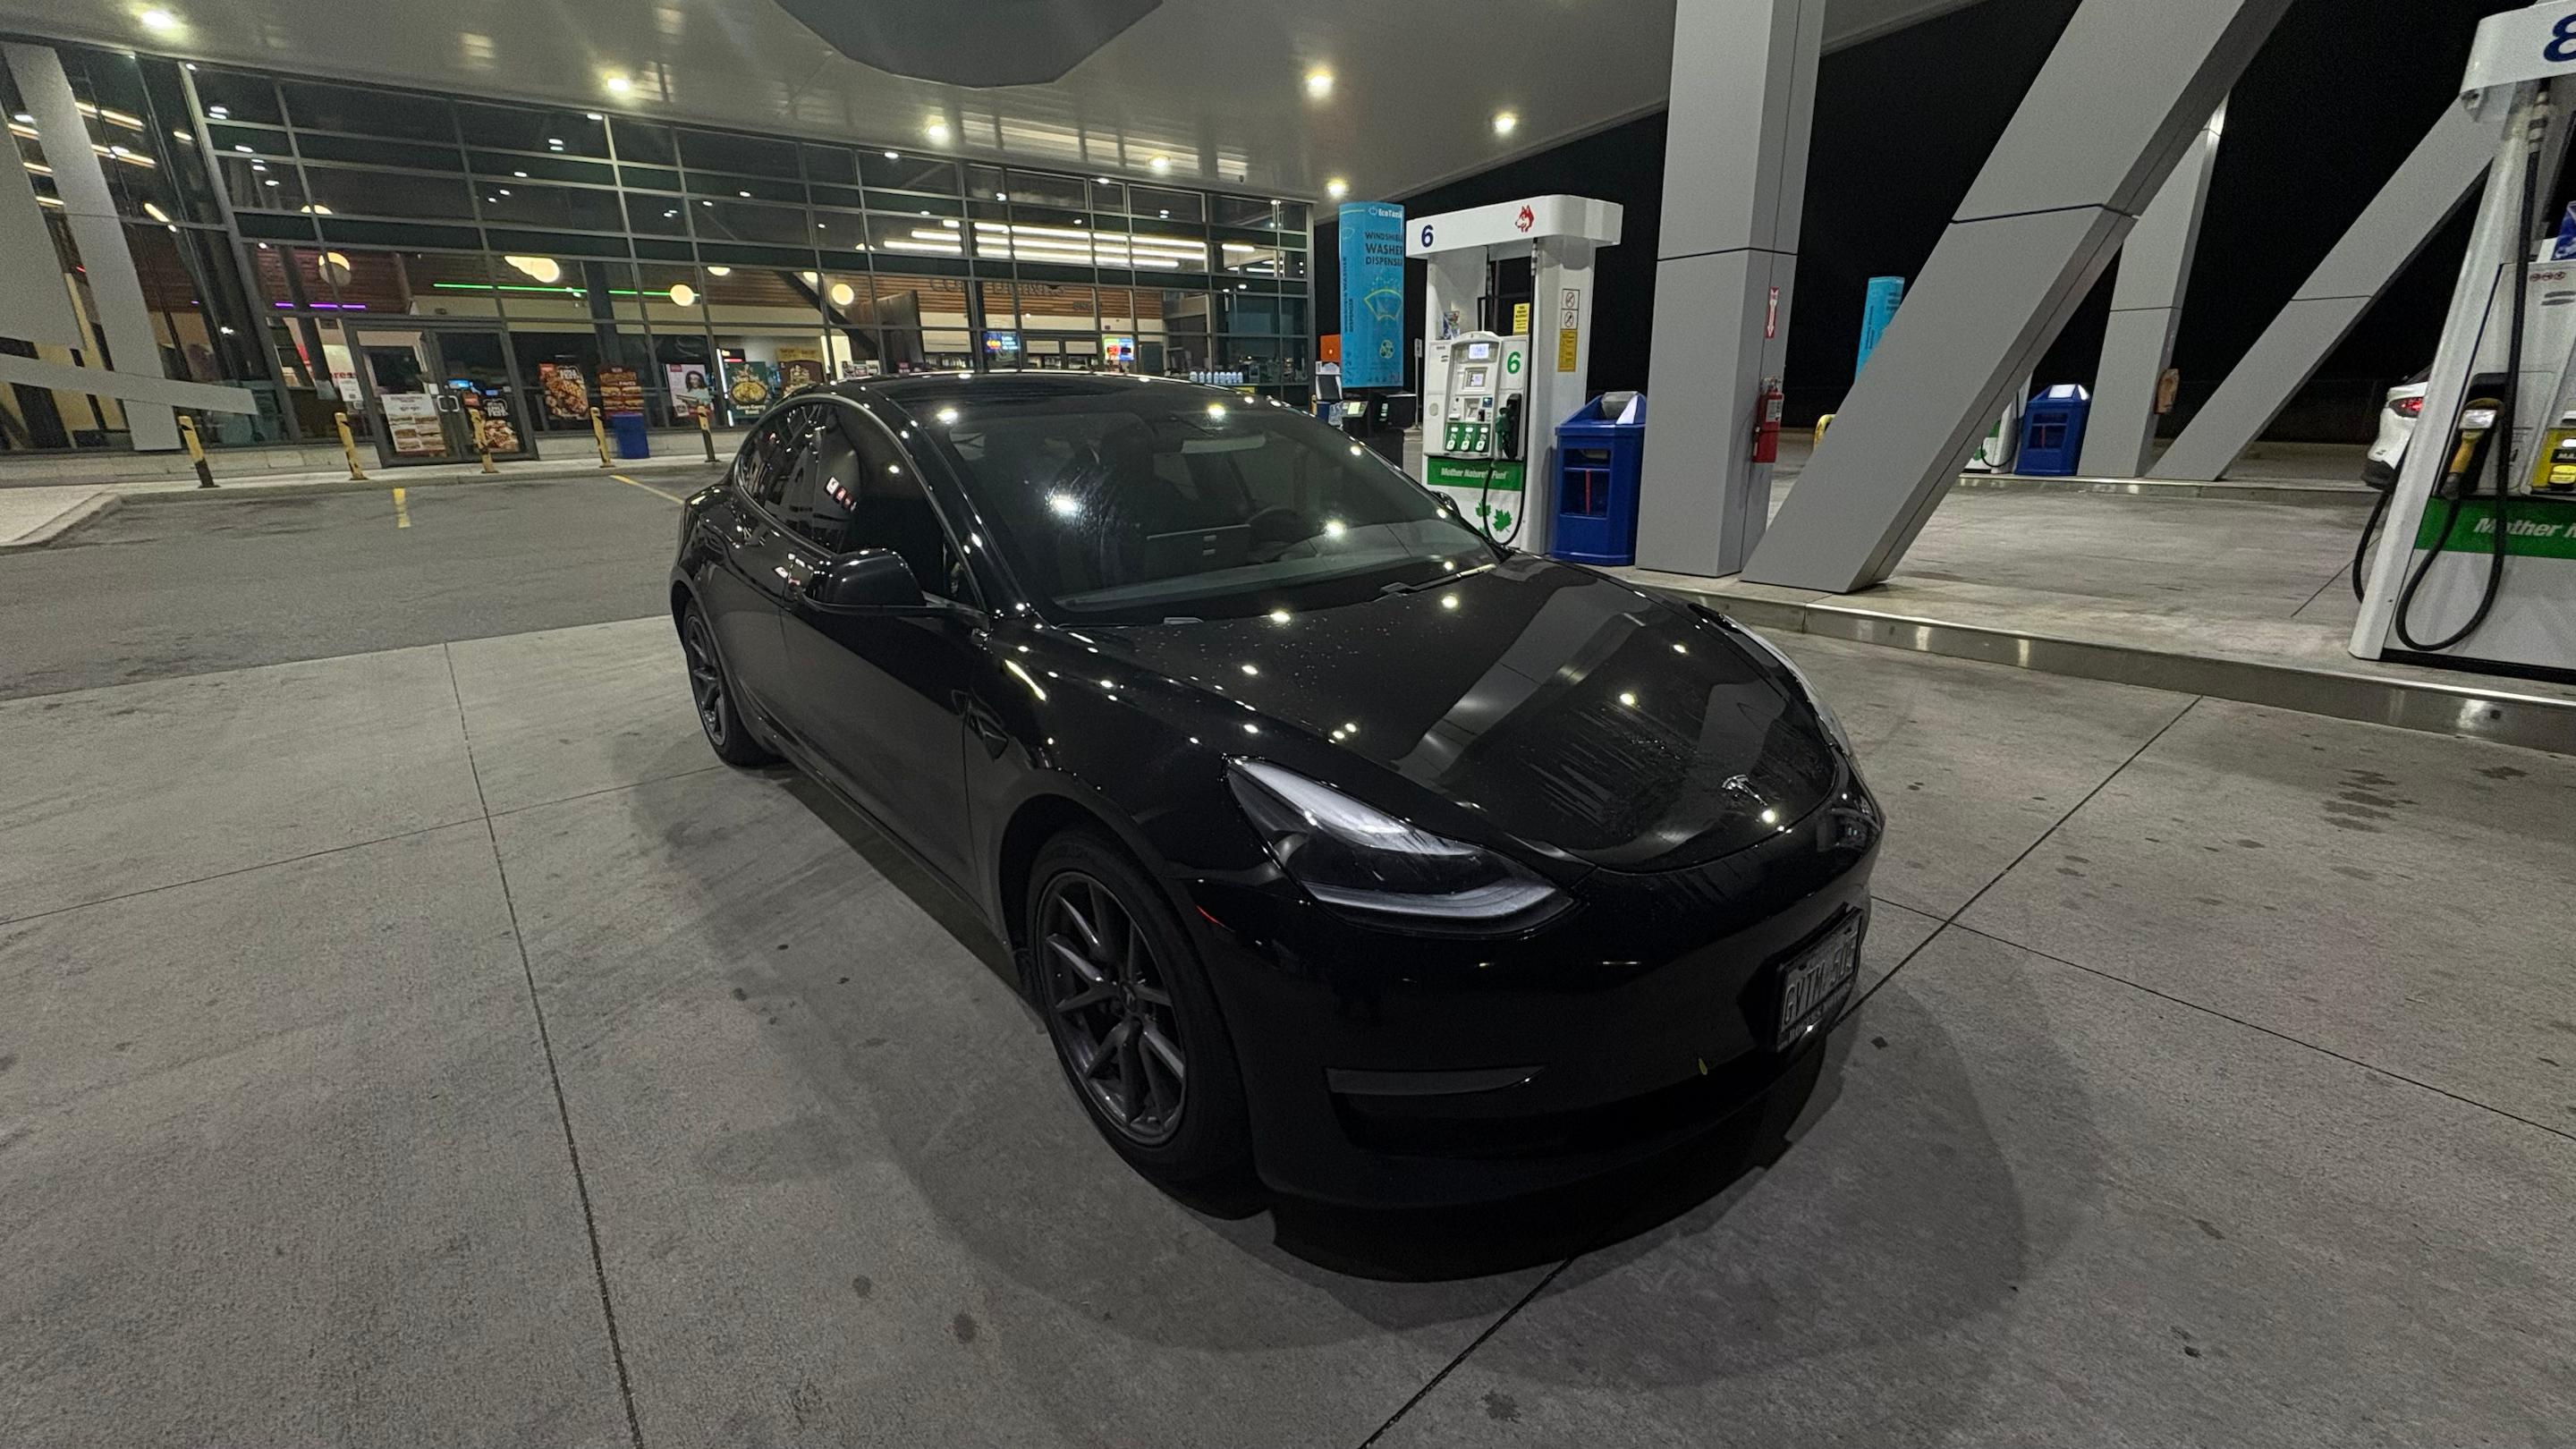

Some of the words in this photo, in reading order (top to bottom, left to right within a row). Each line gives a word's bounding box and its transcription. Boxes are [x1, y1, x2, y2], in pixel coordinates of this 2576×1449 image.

[2544, 13, 2576, 63] 8
[1421, 225, 1434, 248] 6
[1506, 351, 1521, 375] 6
[1440, 467, 1464, 477] Mother
[1491, 470, 1507, 479] Fuel
[2473, 518, 2563, 537] Mther
